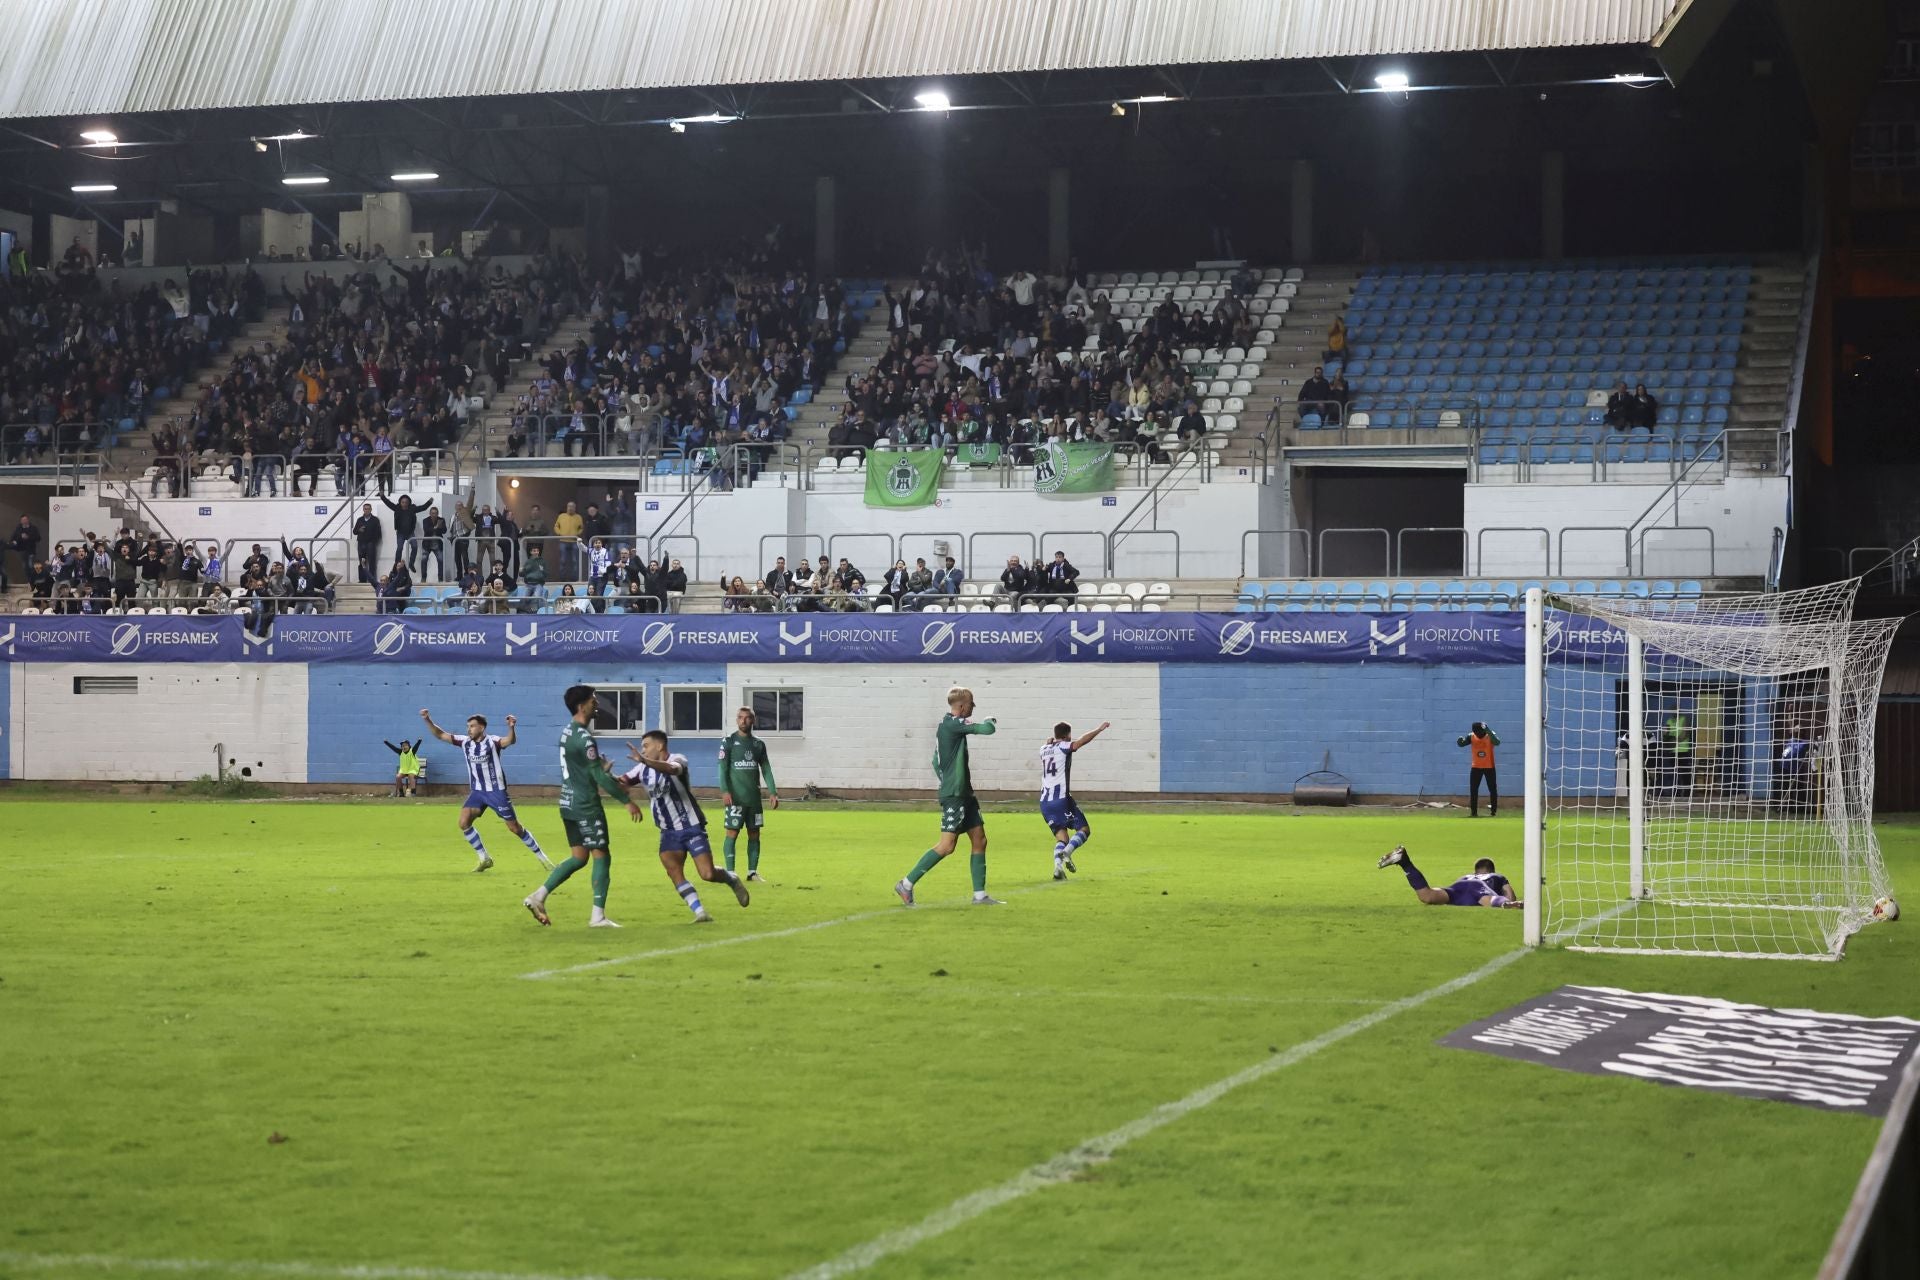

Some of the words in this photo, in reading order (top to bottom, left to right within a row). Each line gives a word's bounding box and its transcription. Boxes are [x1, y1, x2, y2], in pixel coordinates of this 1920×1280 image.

[22, 630, 91, 643] HORIZONTE
[145, 631, 219, 645] FRESAMEX
[280, 630, 353, 643] HORIZONTE
[409, 631, 486, 645] FRESAMEX
[544, 630, 620, 643] HORIZONTE
[678, 630, 759, 645] FRESAMEX
[819, 629, 899, 642] HORIZONTE
[960, 630, 1043, 644] FRESAMEX
[1113, 628, 1196, 642] HORIZONTE
[1260, 630, 1348, 645] FRESAMEX
[1414, 628, 1501, 642] HORIZONTE
[1569, 630, 1629, 644] FRESA
[1042, 756, 1058, 777] 14
[730, 805, 742, 817] 22
